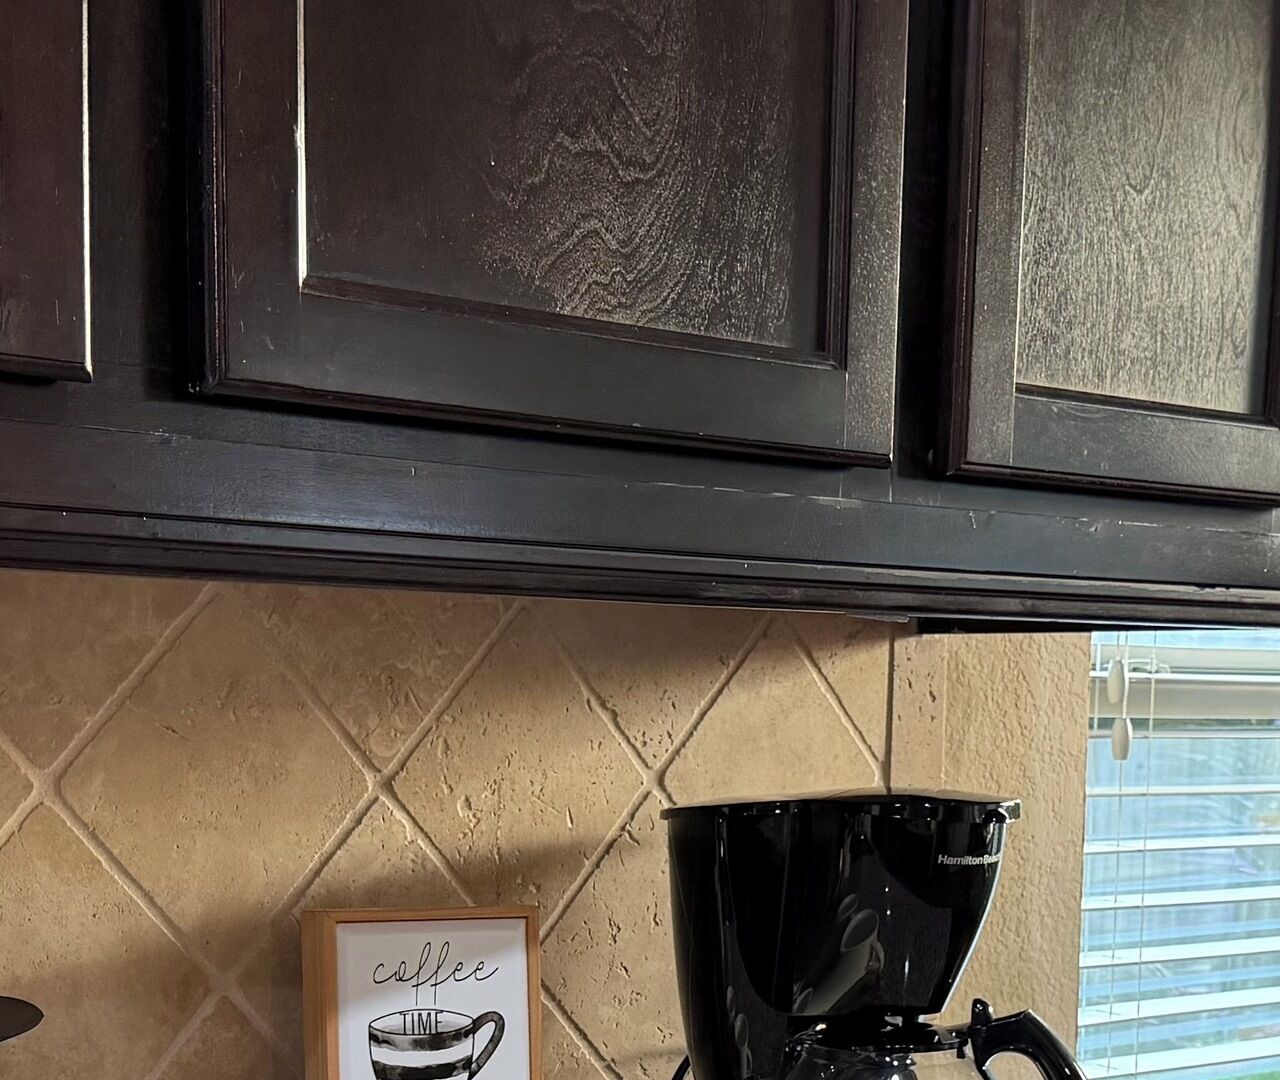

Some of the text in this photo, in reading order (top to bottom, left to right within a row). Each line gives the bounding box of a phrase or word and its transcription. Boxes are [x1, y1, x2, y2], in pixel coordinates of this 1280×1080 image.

[937, 853, 1000, 865] Hamilton Bea
[372, 941, 499, 1006] coffee
[400, 1011, 444, 1035] TIME
